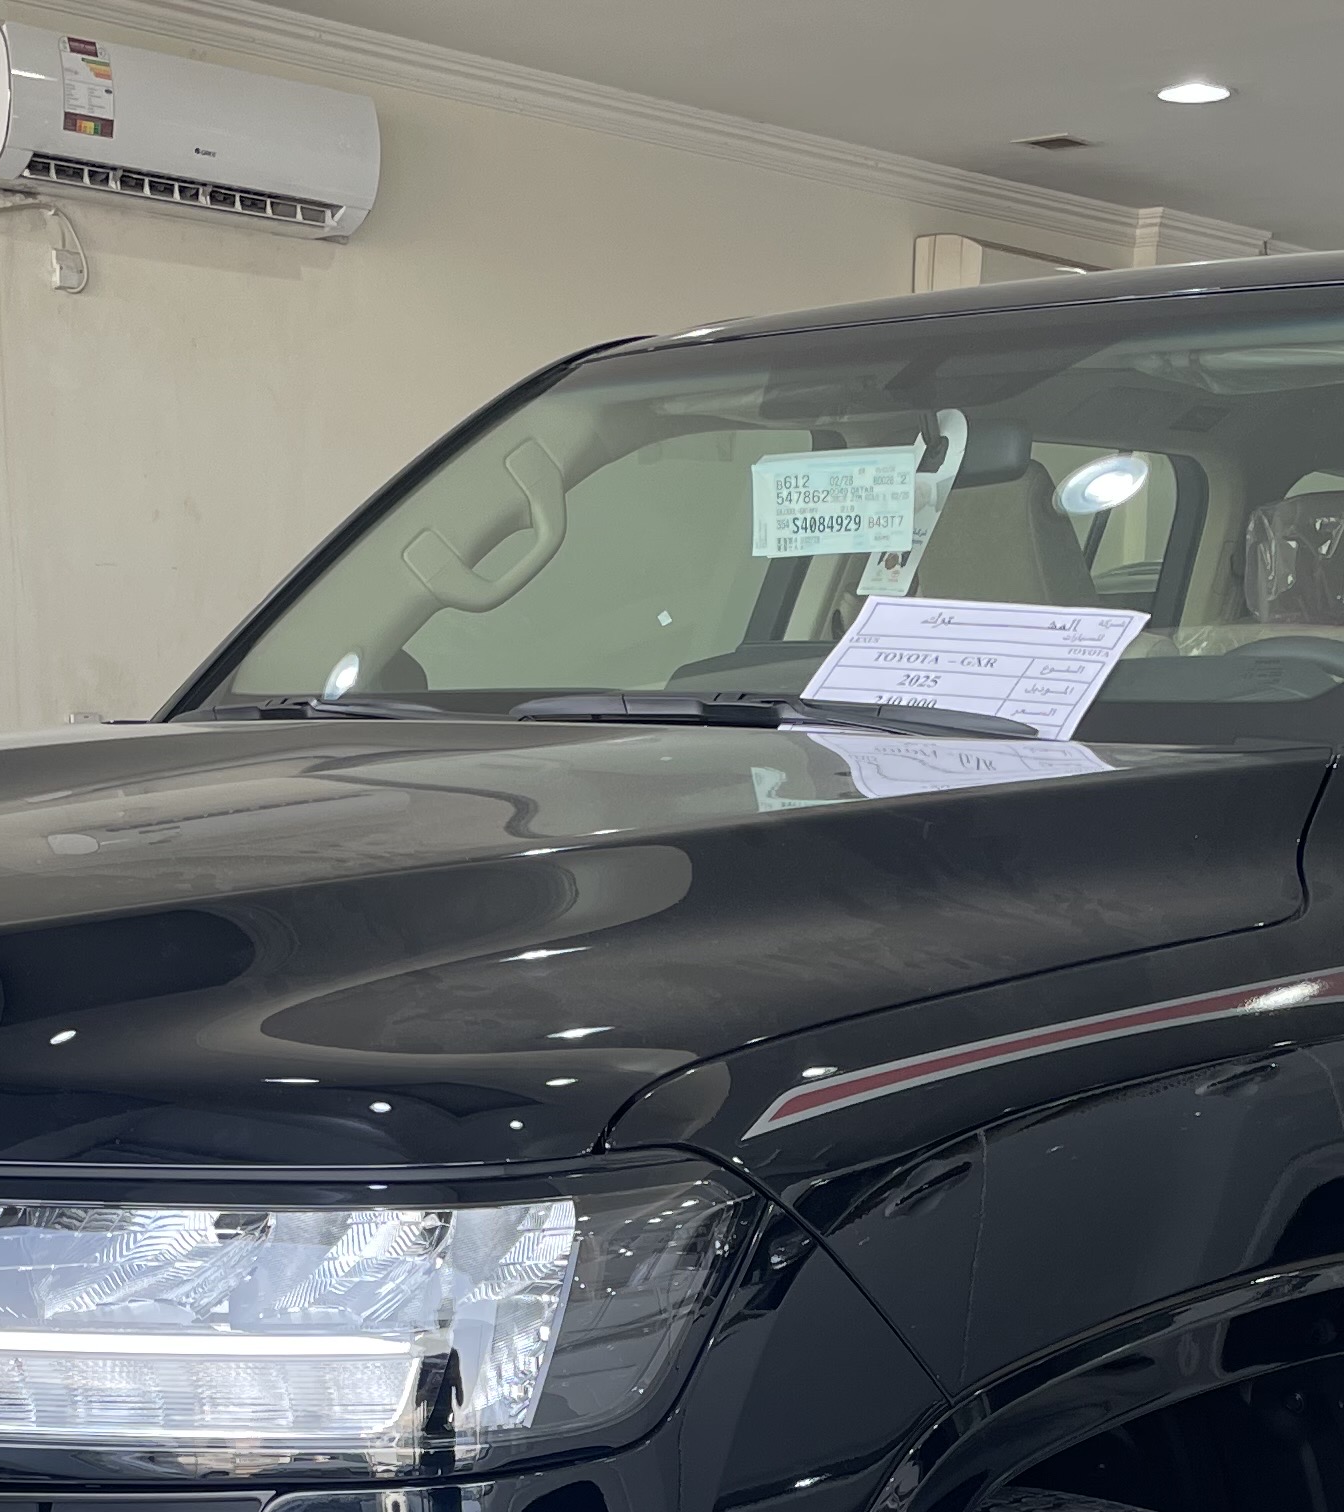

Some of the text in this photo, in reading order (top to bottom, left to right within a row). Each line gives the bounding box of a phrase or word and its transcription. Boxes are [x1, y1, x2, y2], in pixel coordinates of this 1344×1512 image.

[776, 489, 830, 505] 547862
[792, 514, 862, 534] S4084929
[873, 651, 940, 665] TOYOTA
[959, 655, 998, 669] GXR
[896, 673, 942, 689] 2025
